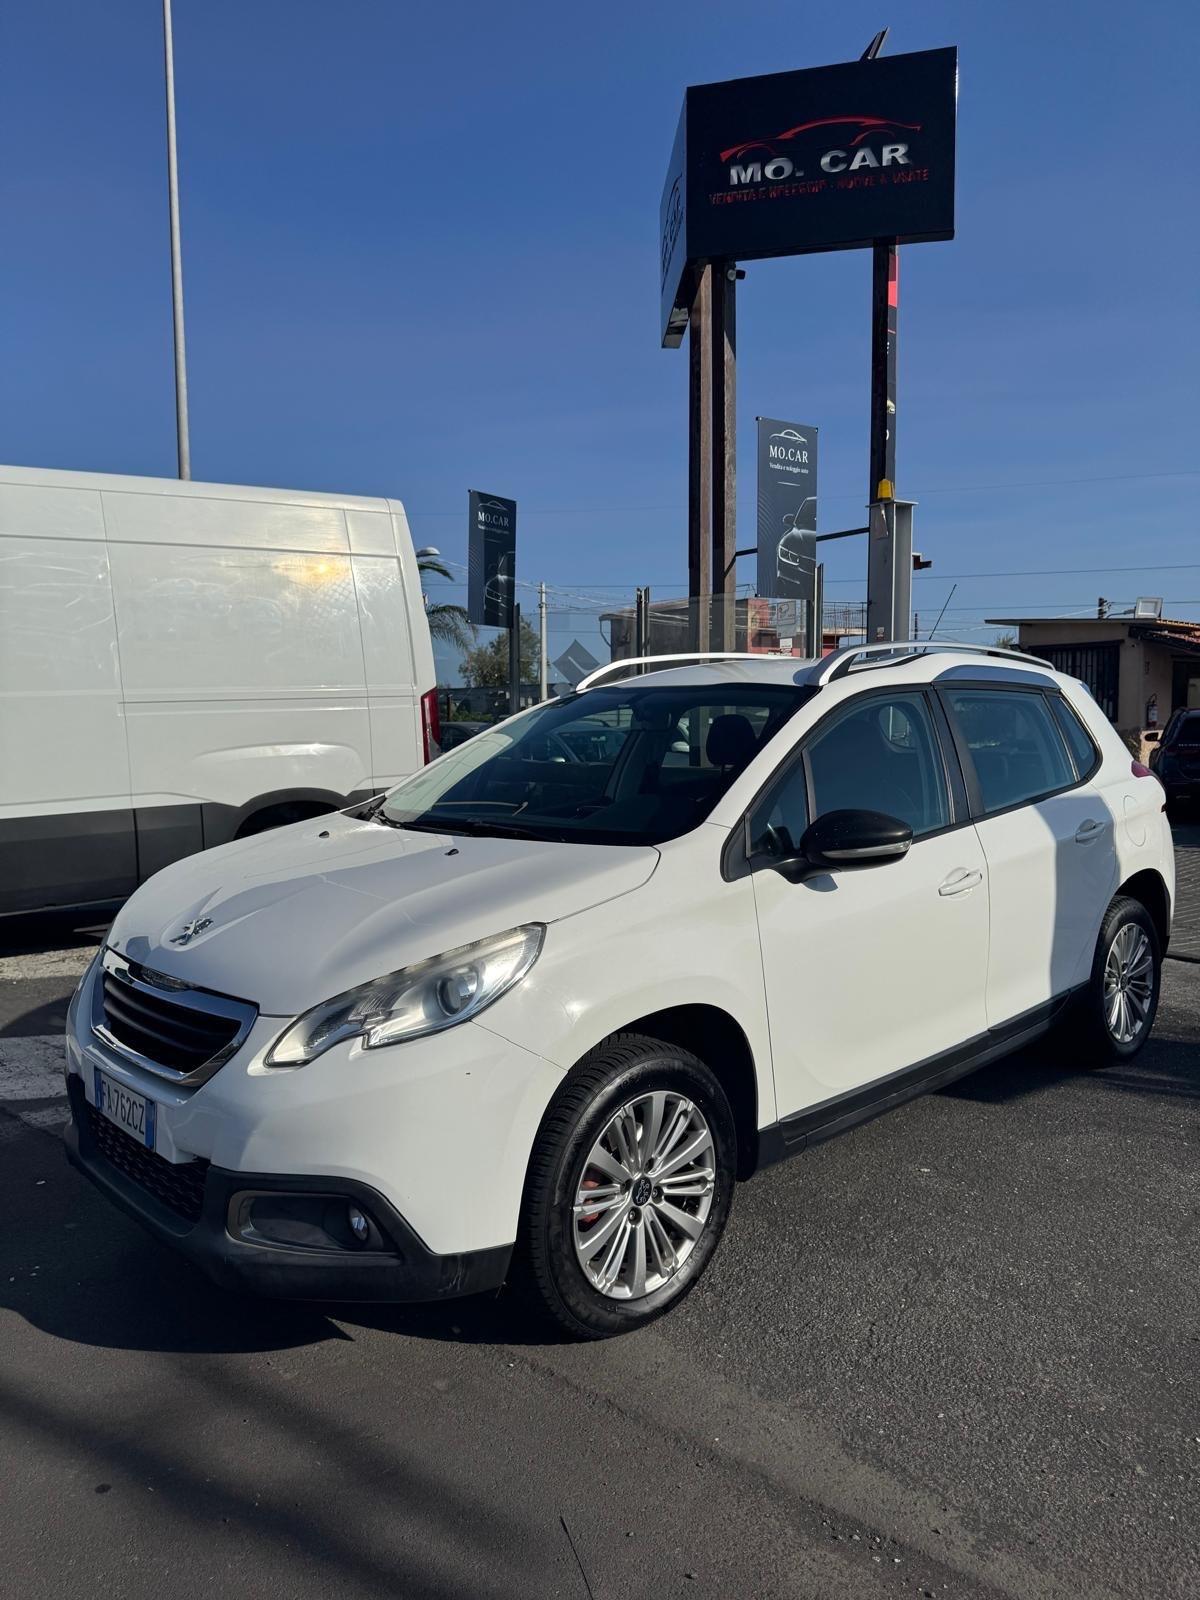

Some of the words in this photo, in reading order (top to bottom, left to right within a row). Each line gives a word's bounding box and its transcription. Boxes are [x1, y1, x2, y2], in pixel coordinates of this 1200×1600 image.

[729, 156, 804, 186] MO.
[820, 143, 911, 173] CAR
[769, 444, 809, 463] MO.CAR
[478, 511, 509, 527] MO.CAR
